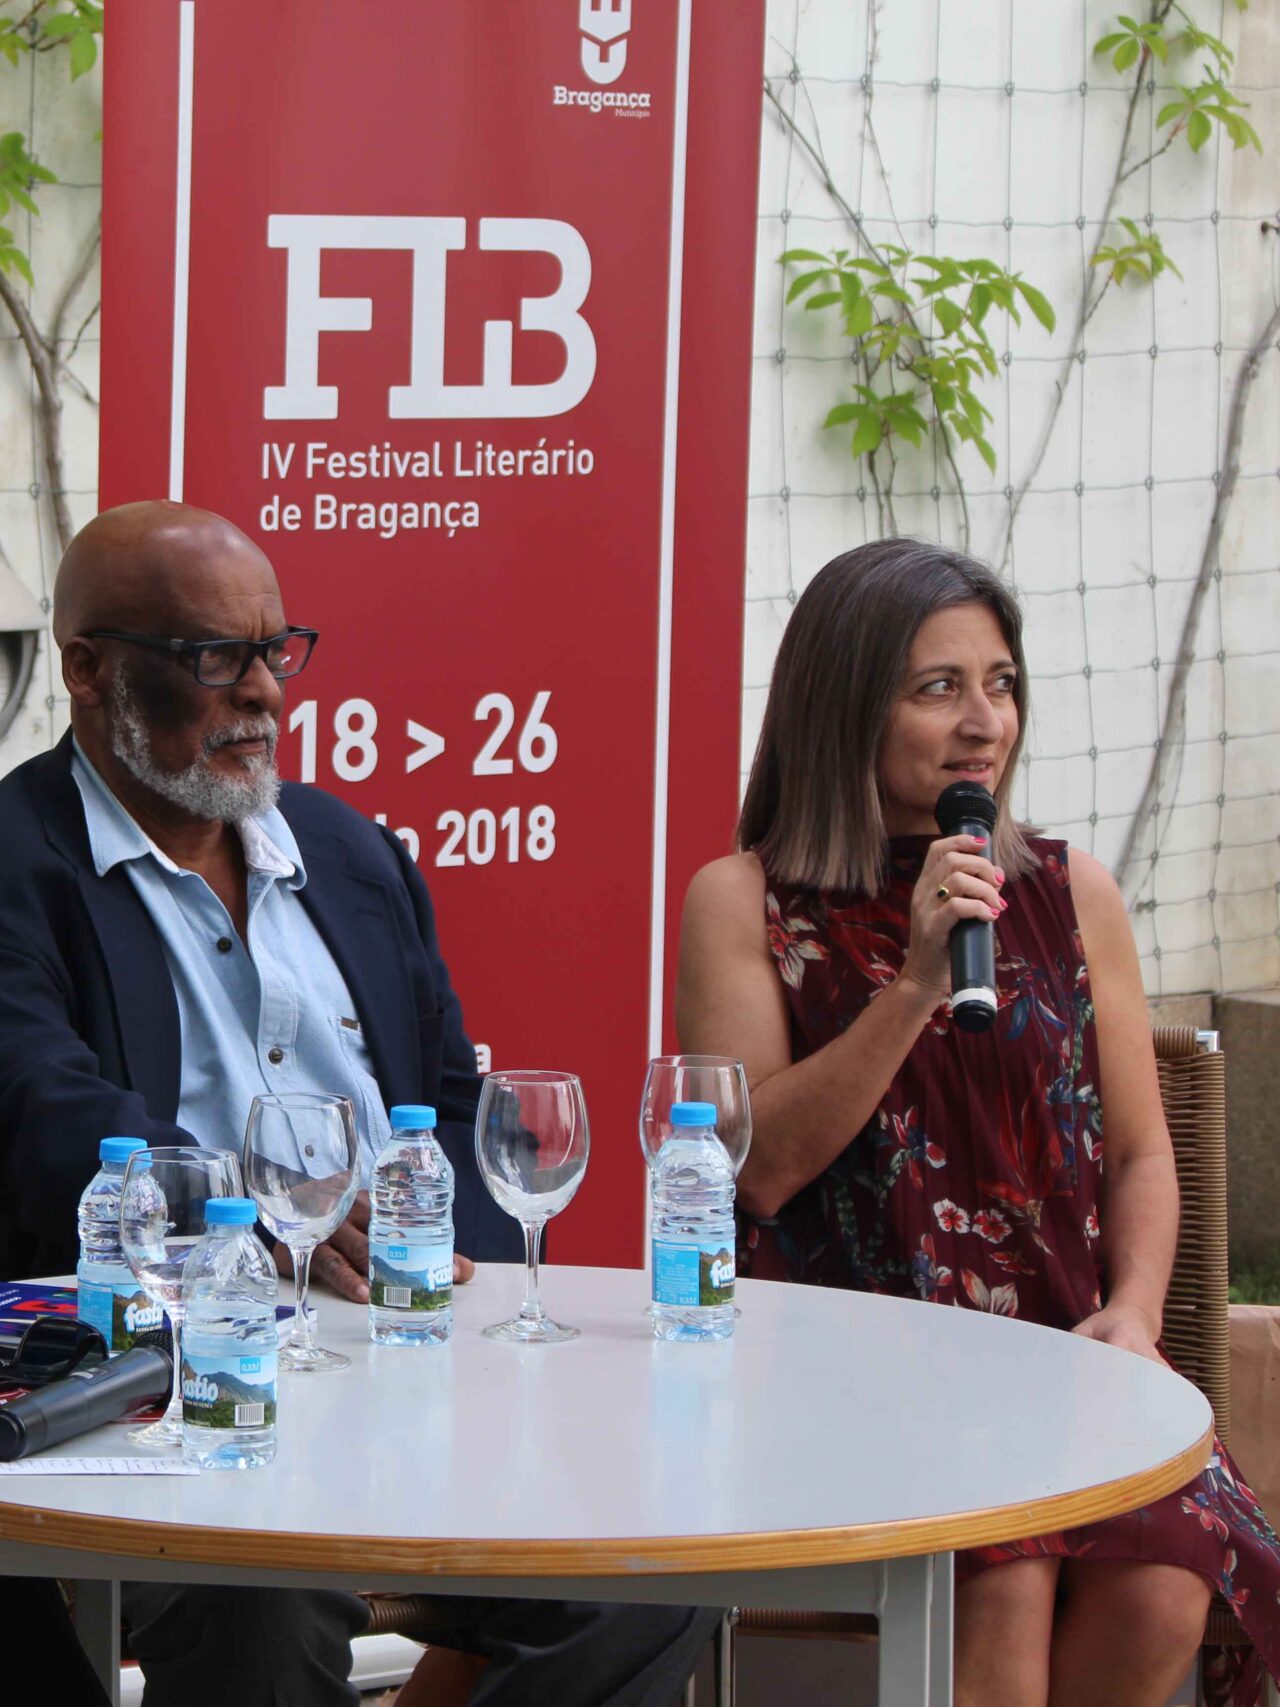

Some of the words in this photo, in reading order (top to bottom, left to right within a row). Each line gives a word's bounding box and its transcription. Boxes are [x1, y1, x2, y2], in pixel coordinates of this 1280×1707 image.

[552, 85, 651, 113] Bragança
[262, 442, 296, 480] IV
[306, 441, 443, 479] Festival
[454, 437, 594, 477] Literário
[259, 494, 302, 532] de
[314, 493, 480, 539] Bragança
[289, 698, 378, 784] 18
[472, 690, 558, 776] 26
[435, 804, 556, 867] 2018
